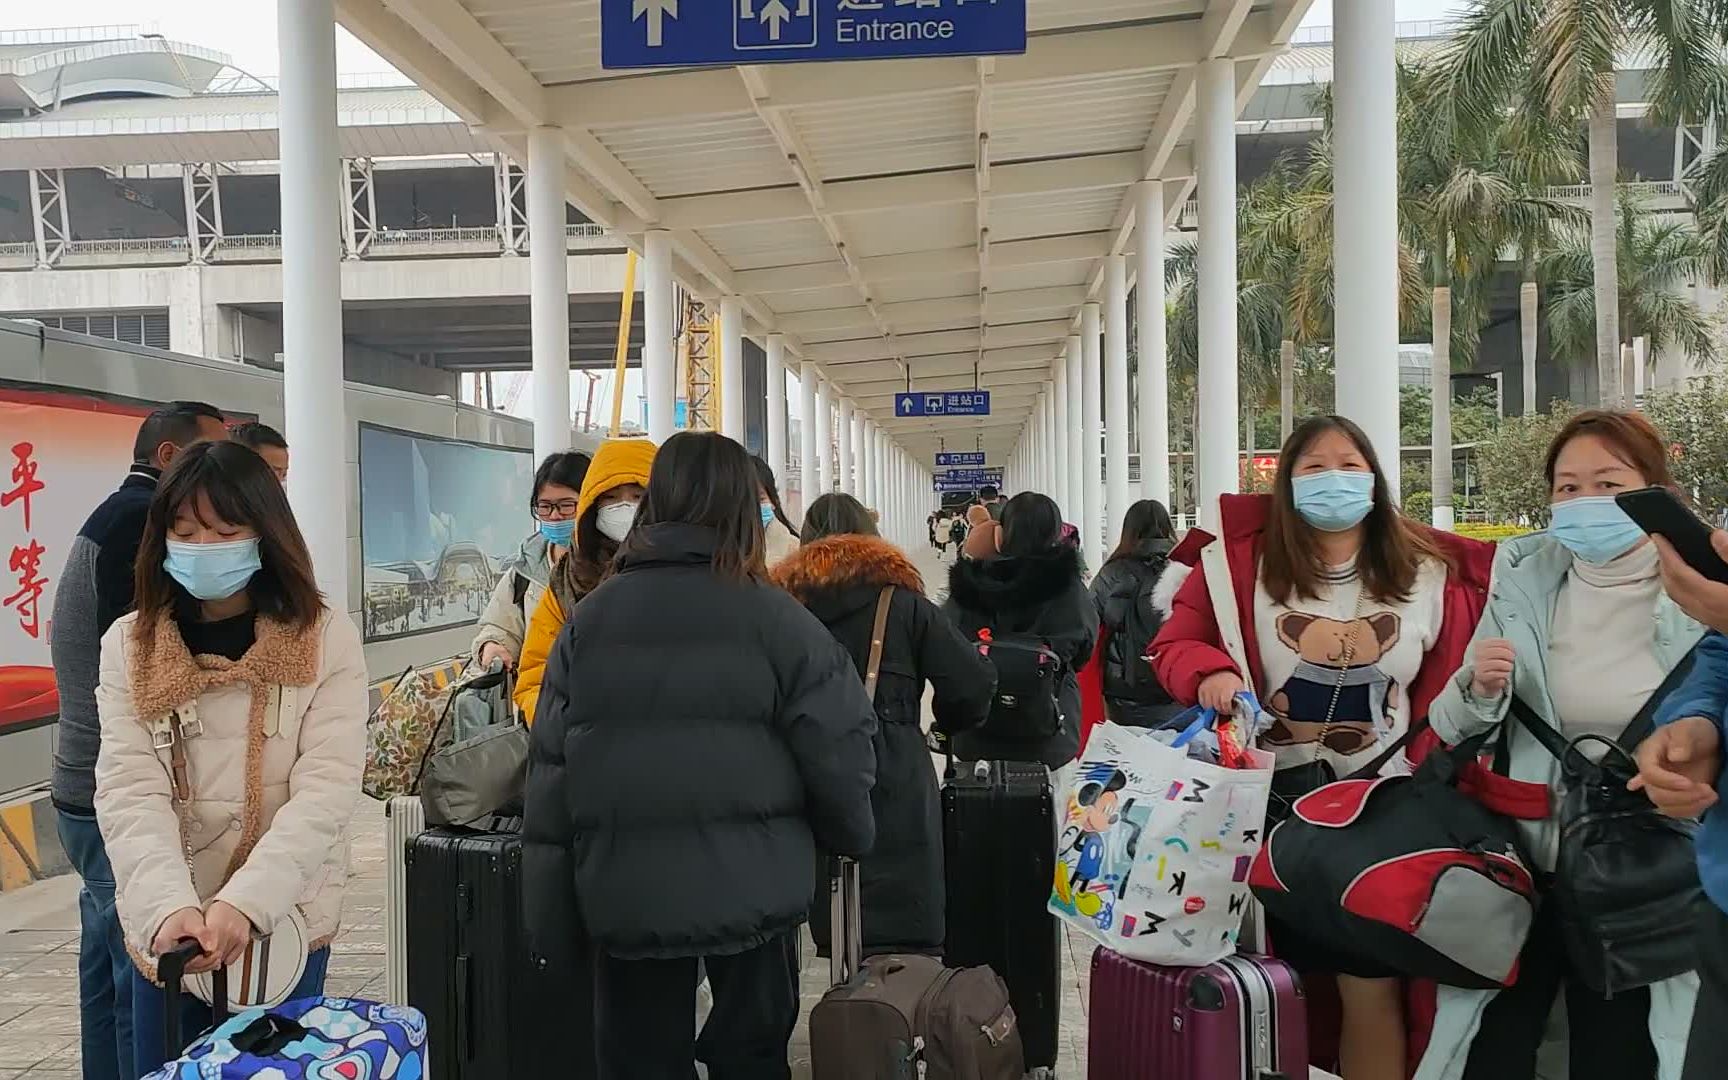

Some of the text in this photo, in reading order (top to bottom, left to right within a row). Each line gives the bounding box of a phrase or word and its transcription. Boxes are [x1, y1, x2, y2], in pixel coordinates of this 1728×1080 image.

[836, 18, 954, 42] Entrance
[947, 394, 984, 406] 进站口
[1, 441, 49, 638] 平等
